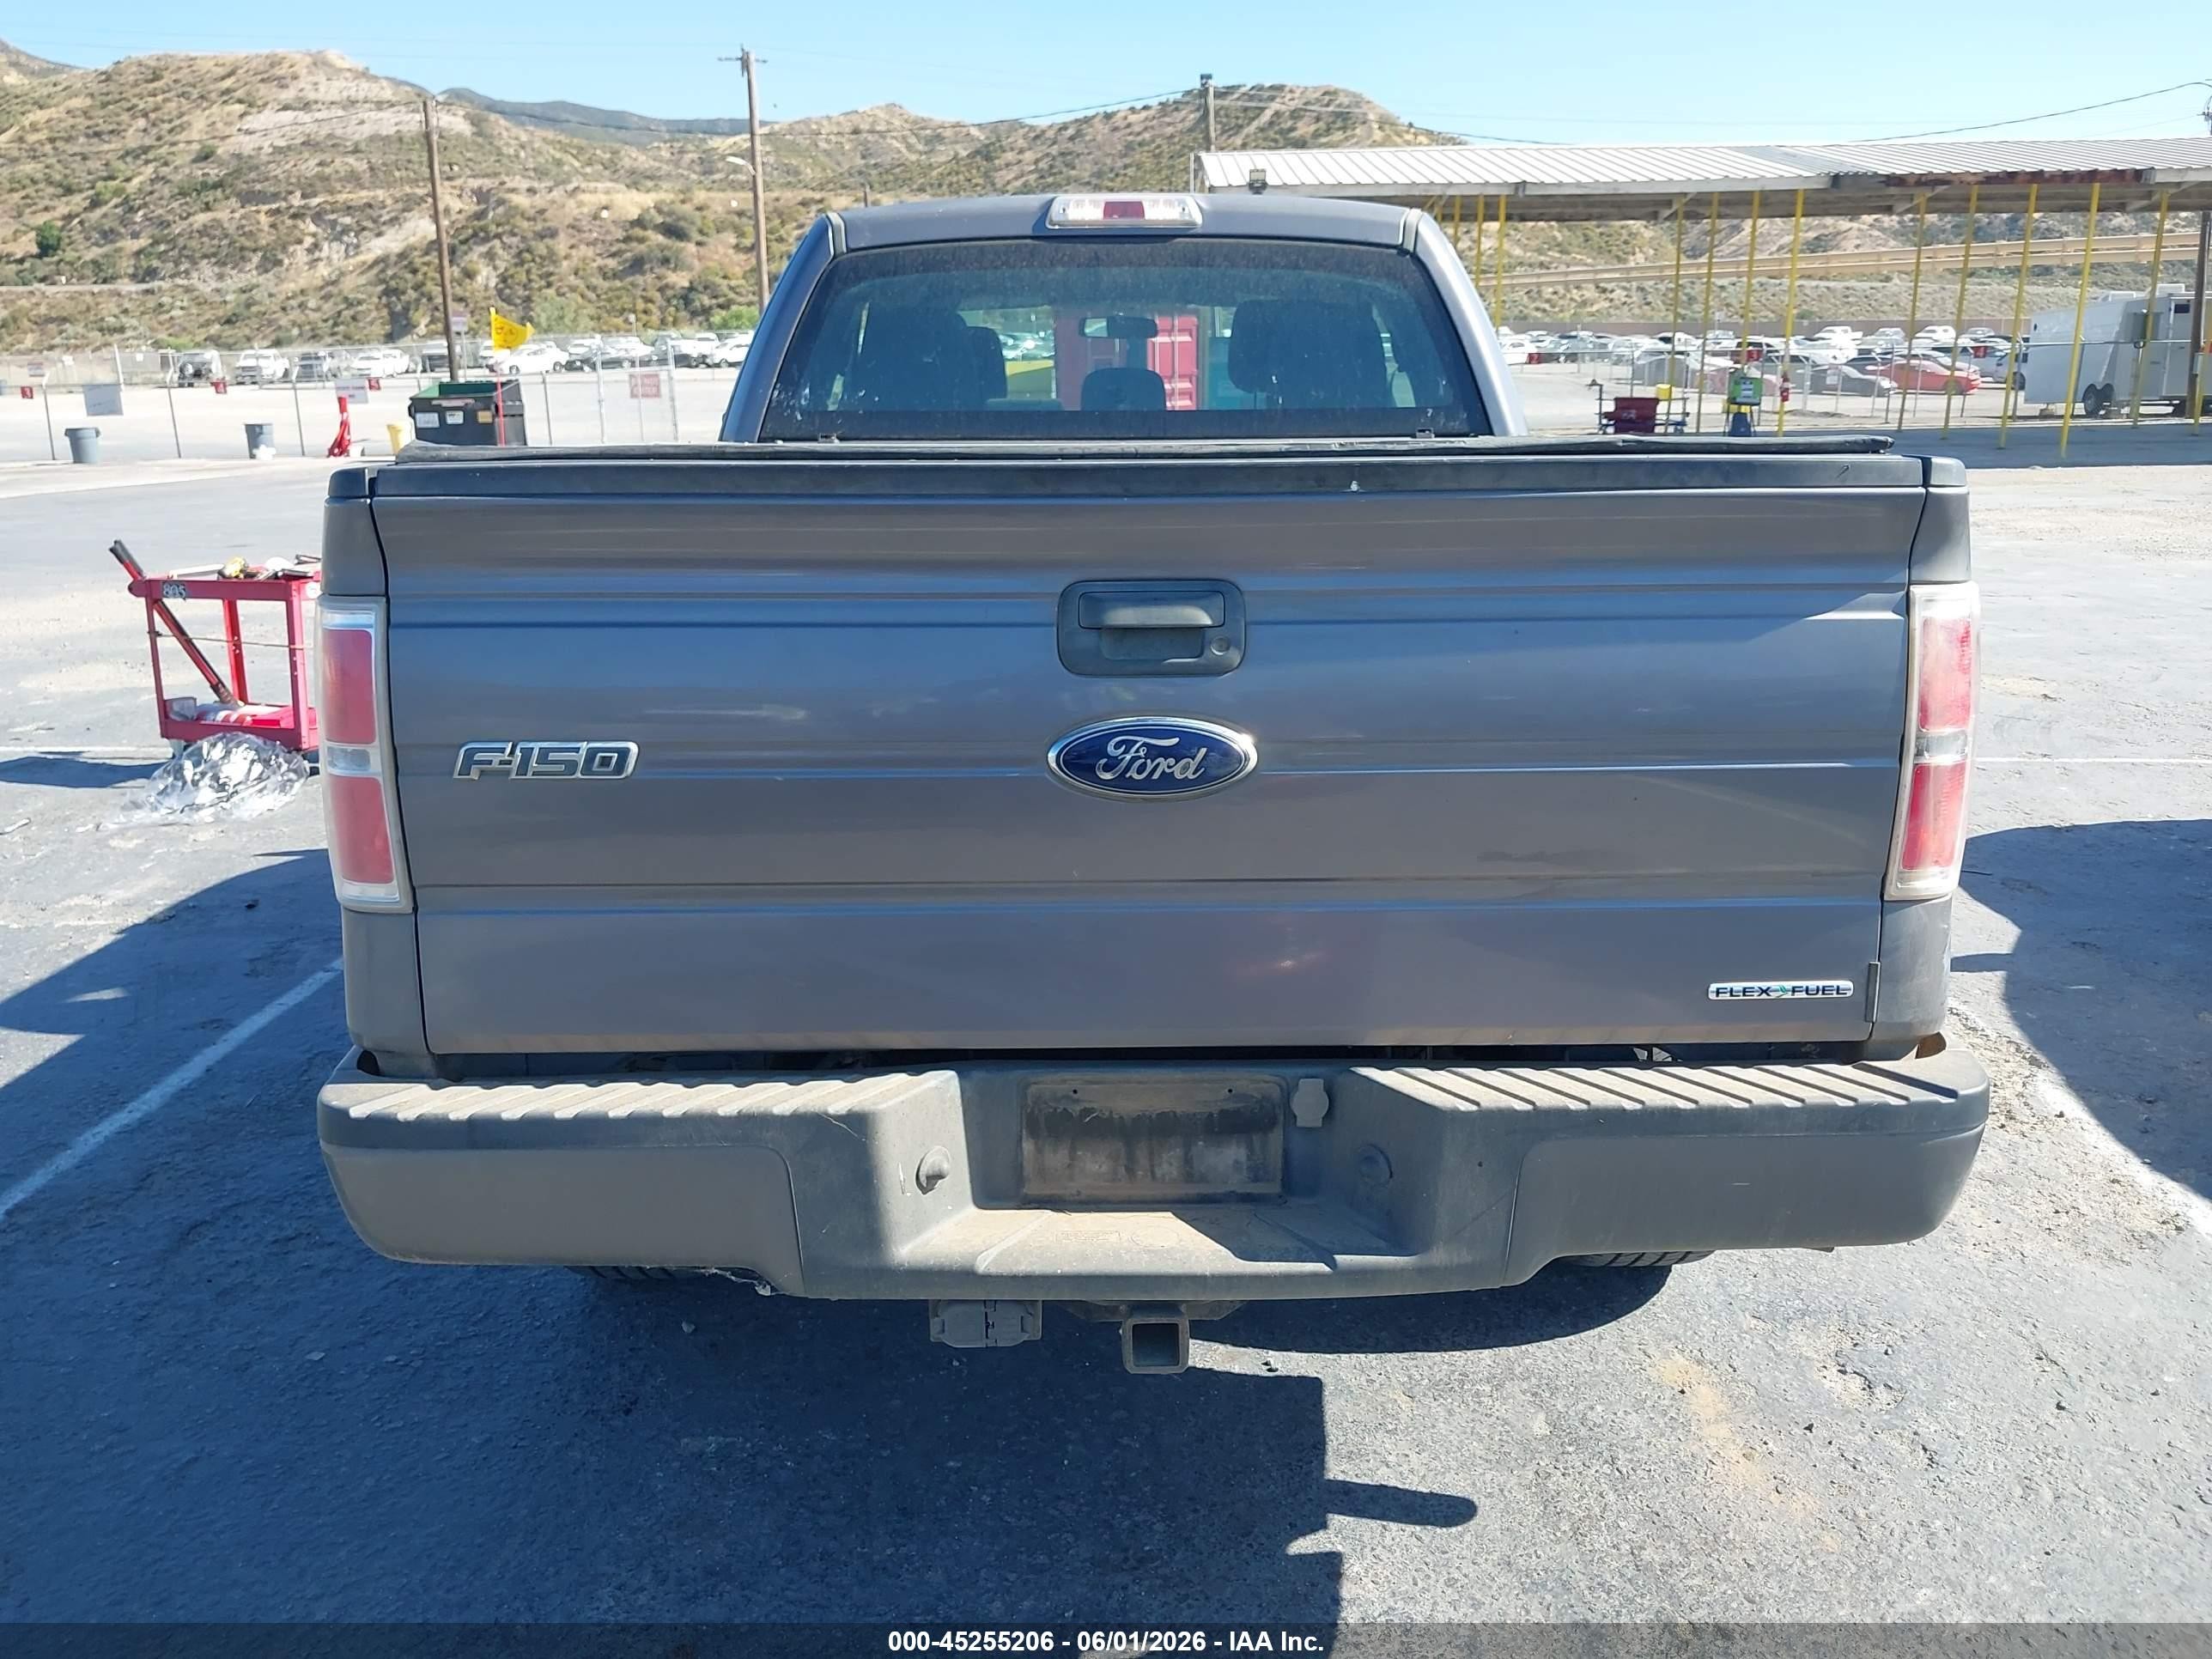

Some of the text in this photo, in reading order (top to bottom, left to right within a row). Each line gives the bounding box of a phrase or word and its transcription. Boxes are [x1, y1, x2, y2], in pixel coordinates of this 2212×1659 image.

[453, 741, 640, 780] F-150
[1095, 735, 1207, 780] Ford
[1715, 985, 1847, 998] FLEX FUEL
